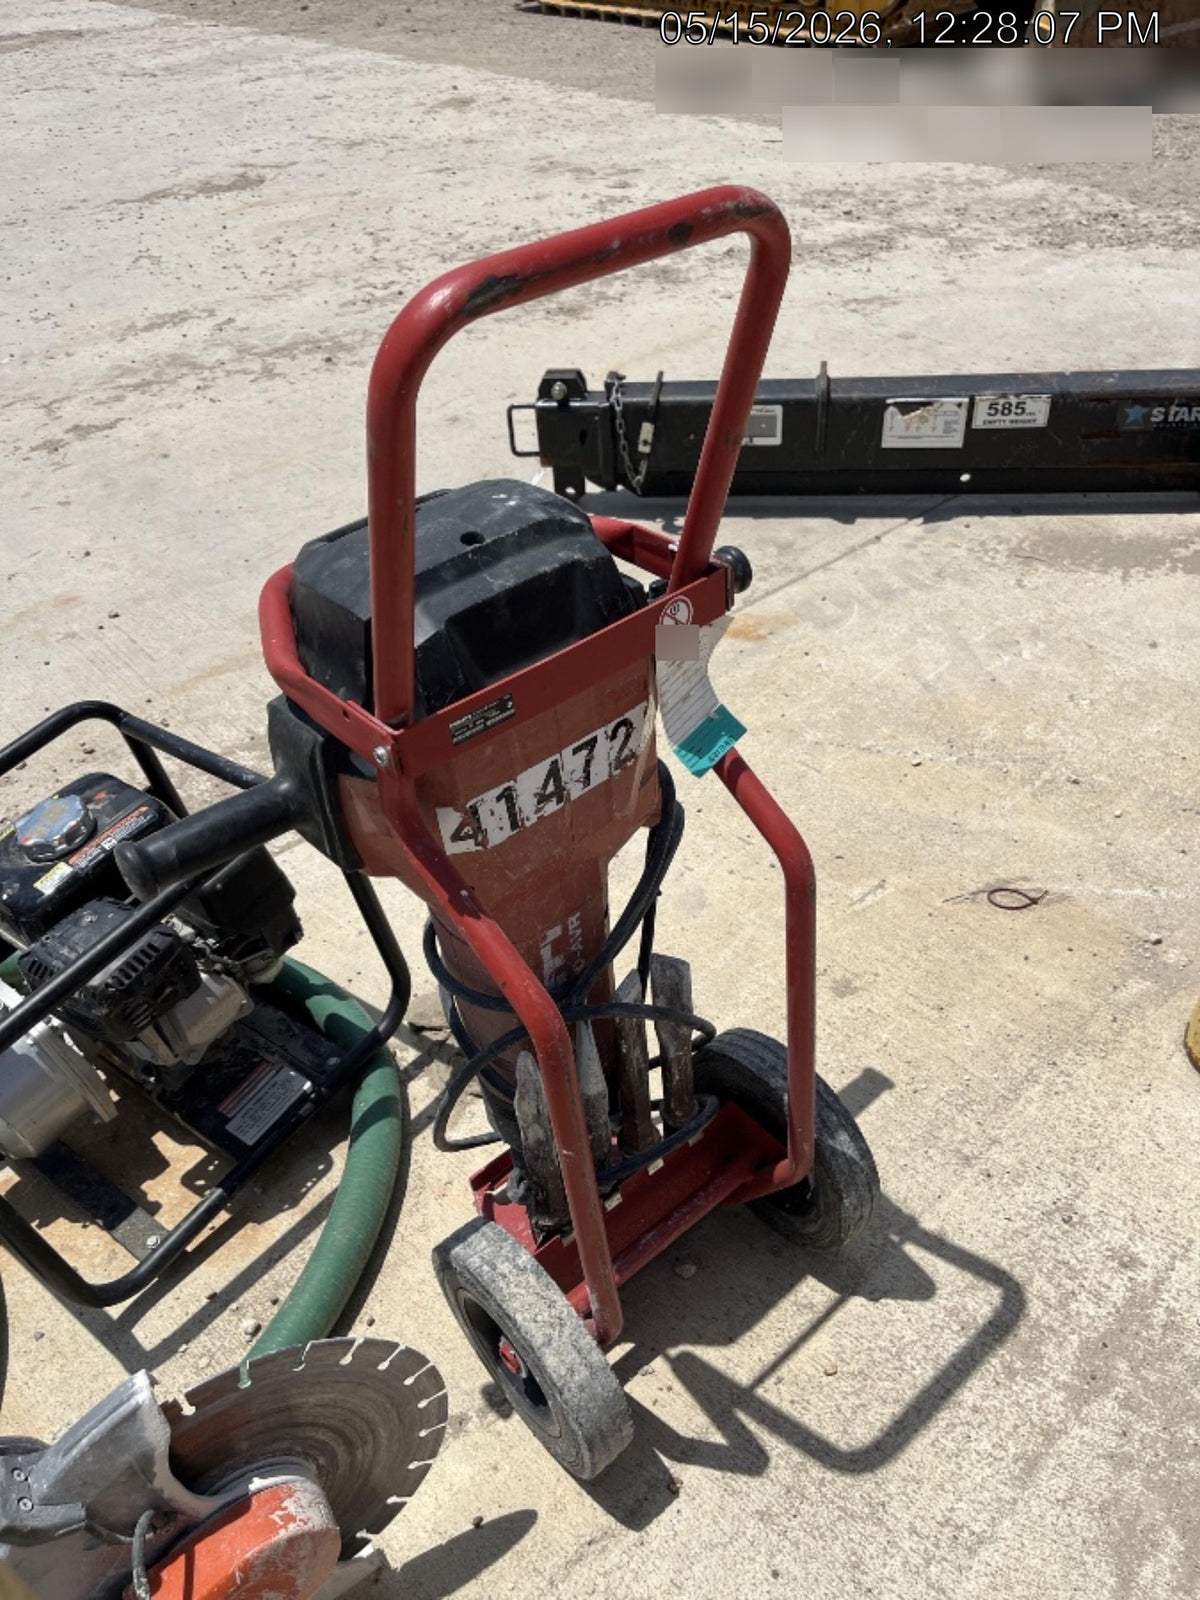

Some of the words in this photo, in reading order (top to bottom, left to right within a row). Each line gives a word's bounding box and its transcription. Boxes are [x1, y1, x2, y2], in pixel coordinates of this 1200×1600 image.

[986, 401, 1027, 417] 585
[1150, 406, 1200, 422] STAR
[449, 717, 639, 847] 41472
